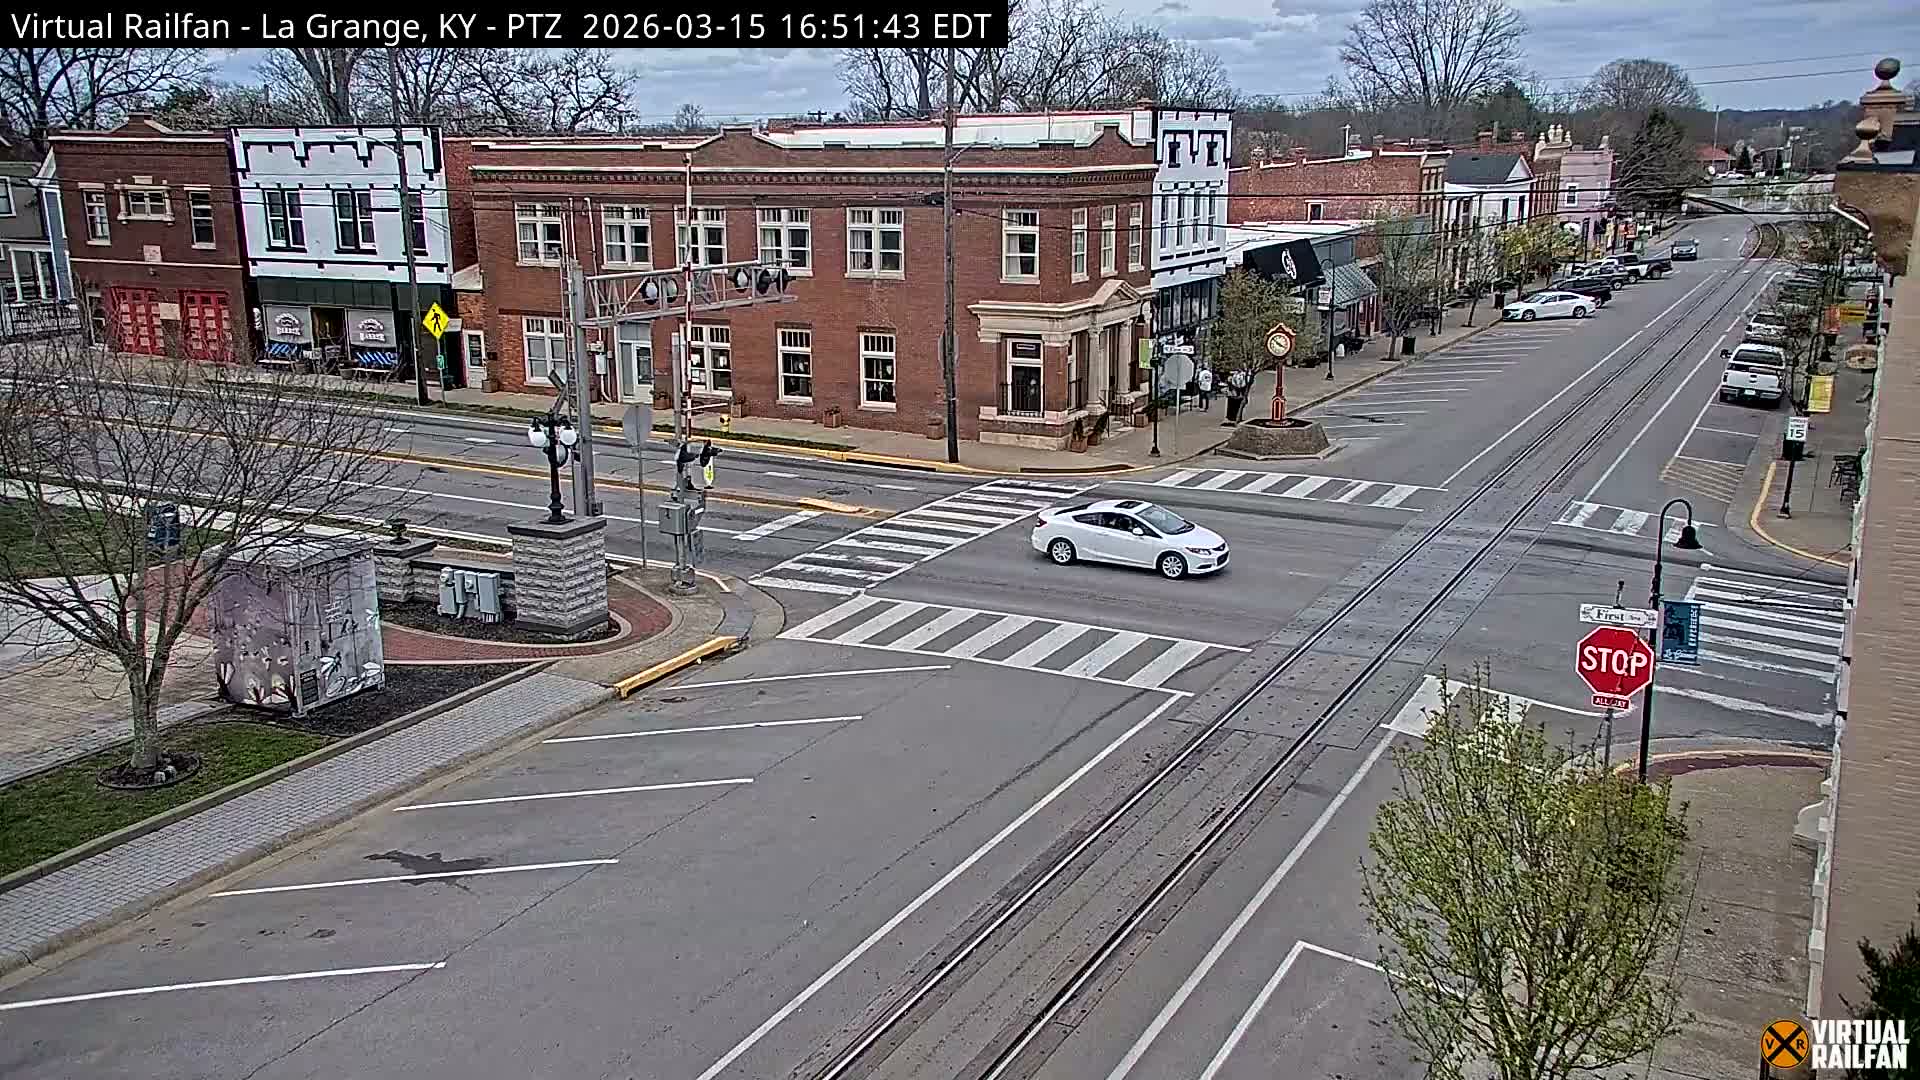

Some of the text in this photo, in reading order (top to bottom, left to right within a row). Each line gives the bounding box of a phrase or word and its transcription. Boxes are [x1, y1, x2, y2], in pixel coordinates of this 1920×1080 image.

[1790, 429, 1805, 438] 15
[1596, 608, 1625, 622] First
[1581, 645, 1648, 677] STOP
